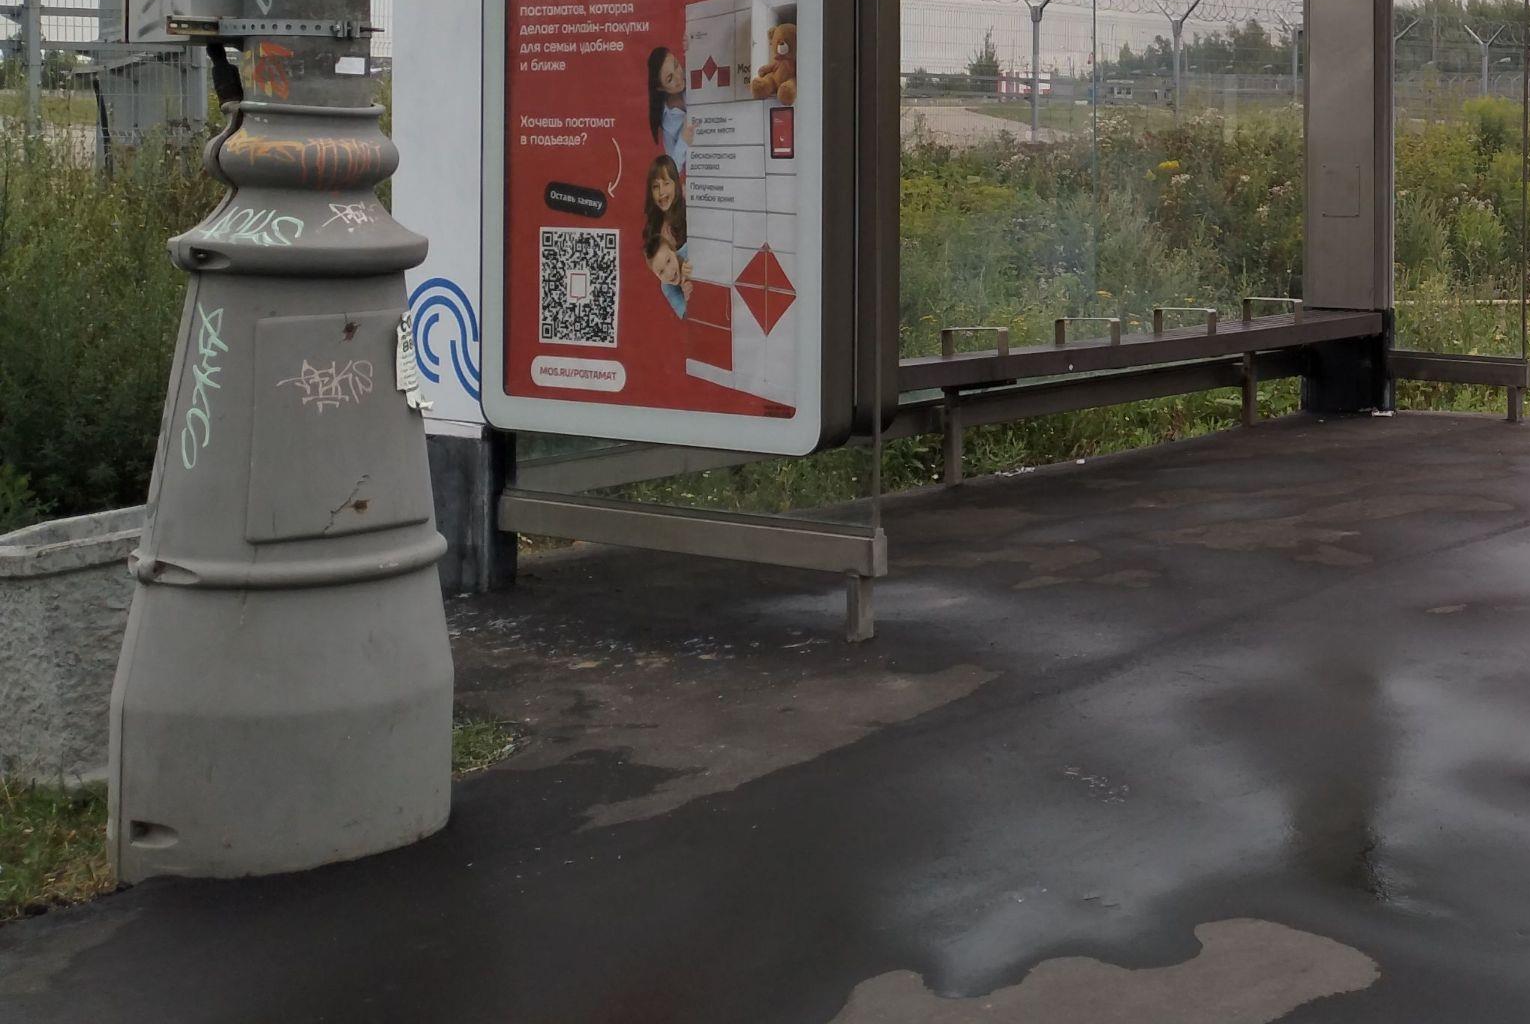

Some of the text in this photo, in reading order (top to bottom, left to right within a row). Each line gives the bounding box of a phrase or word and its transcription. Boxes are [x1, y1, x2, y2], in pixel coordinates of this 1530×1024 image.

[520, 2, 634, 17] постаматов, которая
[519, 20, 650, 36] делает онлайн-покупки
[519, 39, 625, 54] для семьи удобнее
[520, 58, 567, 72] и ближе
[520, 115, 616, 128] Хочешь постамат
[520, 132, 588, 147] в подъезде?
[549, 190, 576, 204] Оставь
[539, 365, 618, 381] MOS.RU/POSTAMAT
